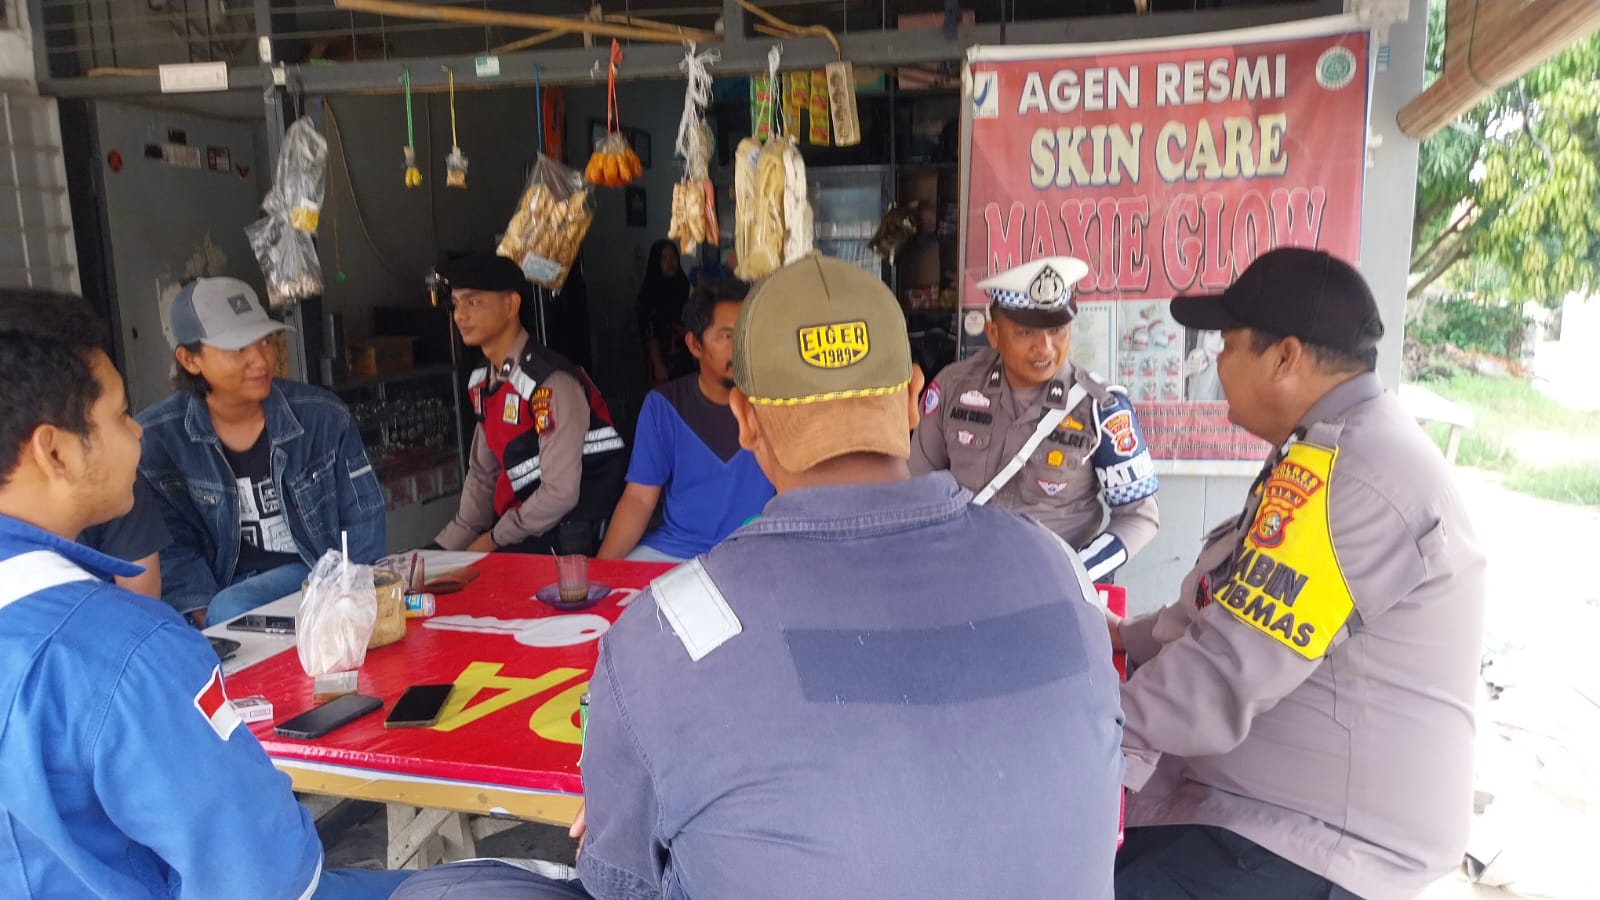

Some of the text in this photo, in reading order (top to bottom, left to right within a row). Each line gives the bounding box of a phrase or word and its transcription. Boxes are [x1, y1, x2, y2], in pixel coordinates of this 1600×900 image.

[1018, 53, 1287, 115] AGEN RESMI
[1030, 112, 1289, 190] SKIN CARE
[984, 187, 1327, 294] MAXIE GLOW
[801, 327, 866, 352] EIGER
[821, 349, 852, 364] 1989
[1271, 486, 1303, 505] RIAU
[1232, 549, 1309, 608] ABIN
